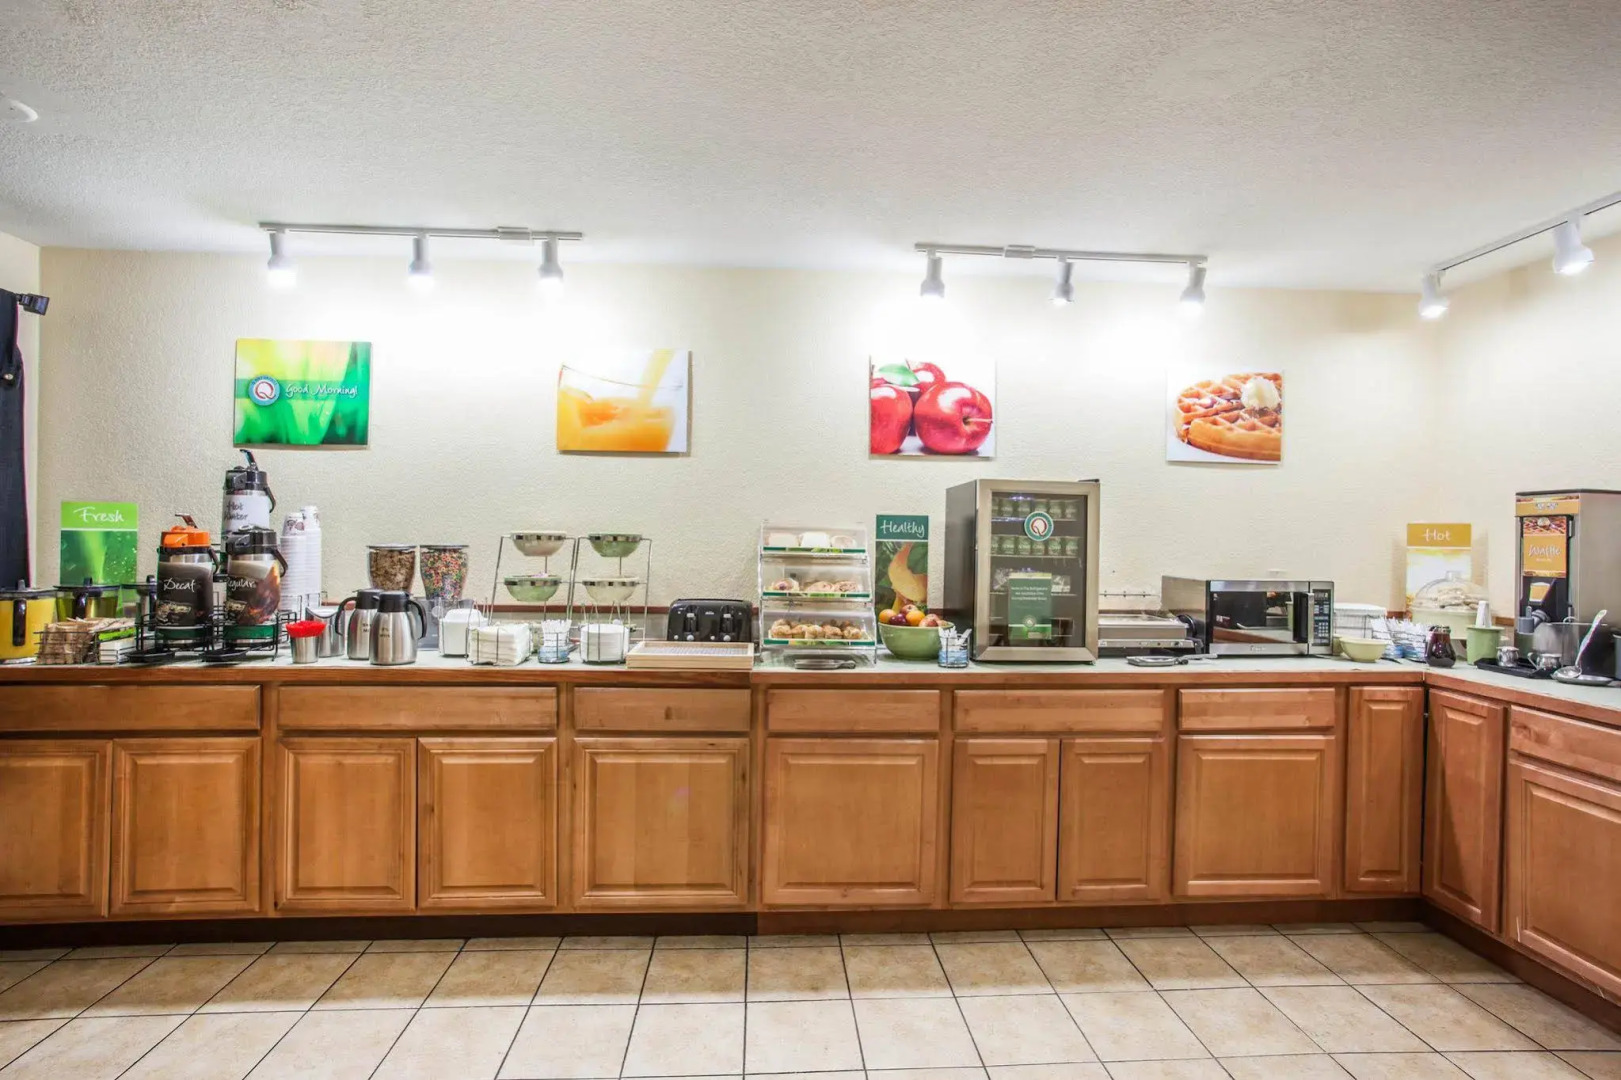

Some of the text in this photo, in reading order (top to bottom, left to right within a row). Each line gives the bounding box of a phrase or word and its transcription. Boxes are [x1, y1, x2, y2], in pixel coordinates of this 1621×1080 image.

[286, 383, 358, 399] Good Morning!
[227, 501, 244, 511] Hot
[73, 506, 125, 523] Fresh
[880, 520, 925, 538] Healthy
[1422, 528, 1451, 542] Hot
[163, 578, 196, 593] Decaf
